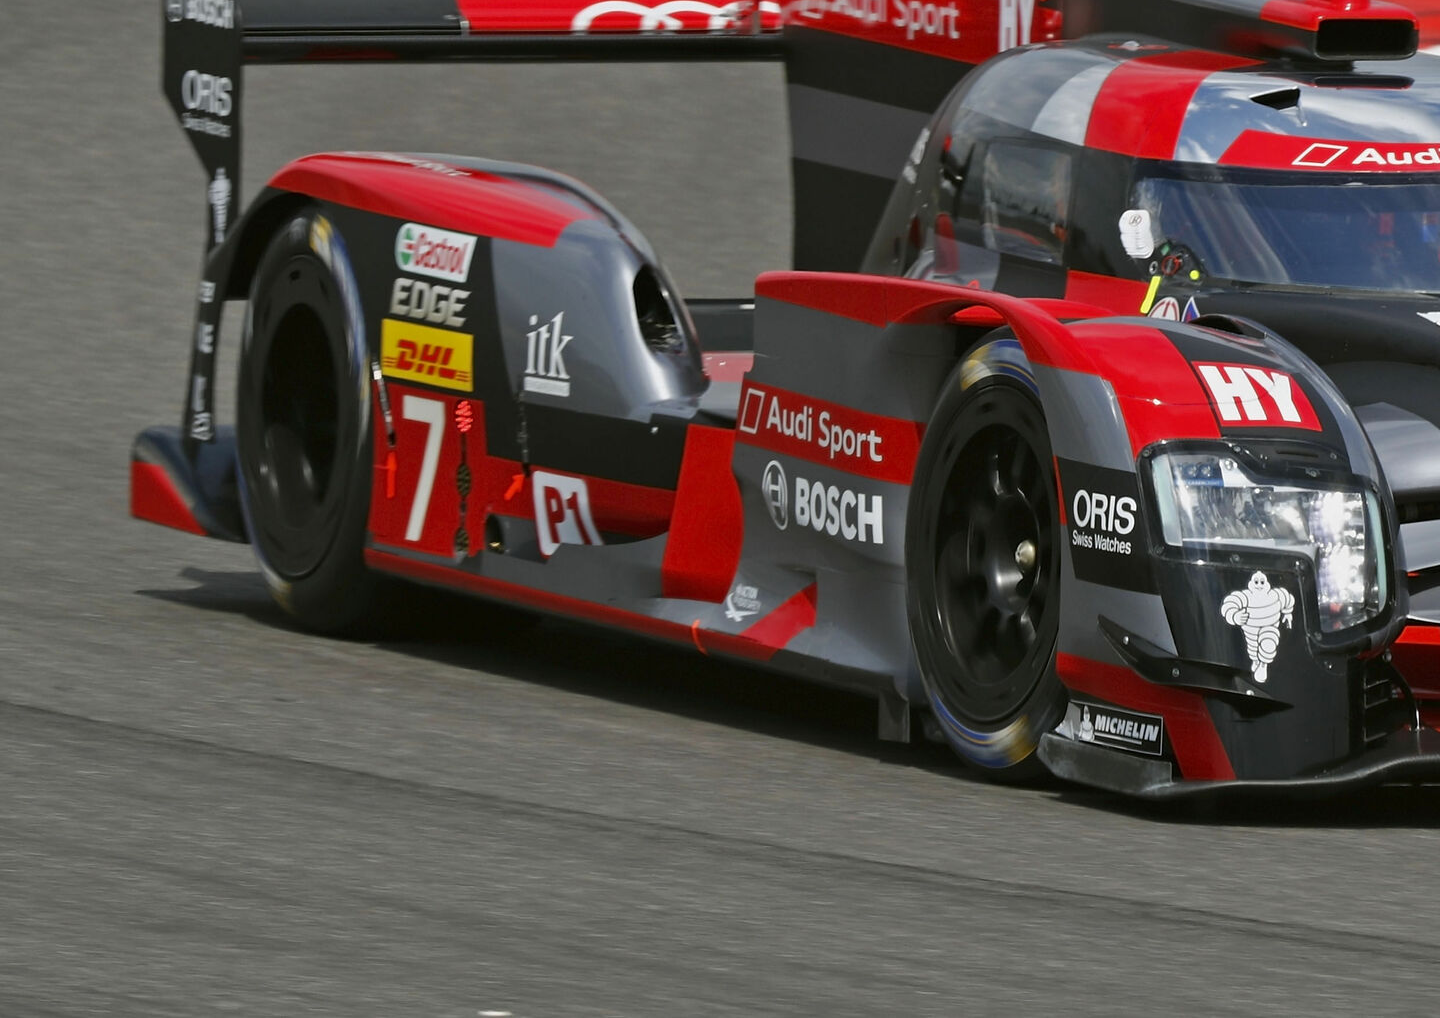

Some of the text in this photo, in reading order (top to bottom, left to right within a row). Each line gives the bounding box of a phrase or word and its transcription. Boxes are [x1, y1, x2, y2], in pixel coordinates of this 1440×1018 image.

[413, 232, 469, 274] Castrol
[389, 277, 472, 328] EDGE
[395, 339, 457, 380] DHL
[525, 311, 575, 380] itk
[1198, 365, 1302, 422] HY
[766, 395, 883, 462] Audi Sport
[403, 394, 446, 542] 7
[543, 484, 593, 545] P1
[795, 476, 884, 545] BOSCH
[1073, 489, 1137, 535] ORIS
[1072, 529, 1132, 555] Swiss Watches
[1094, 713, 1160, 742] MICHELIN
